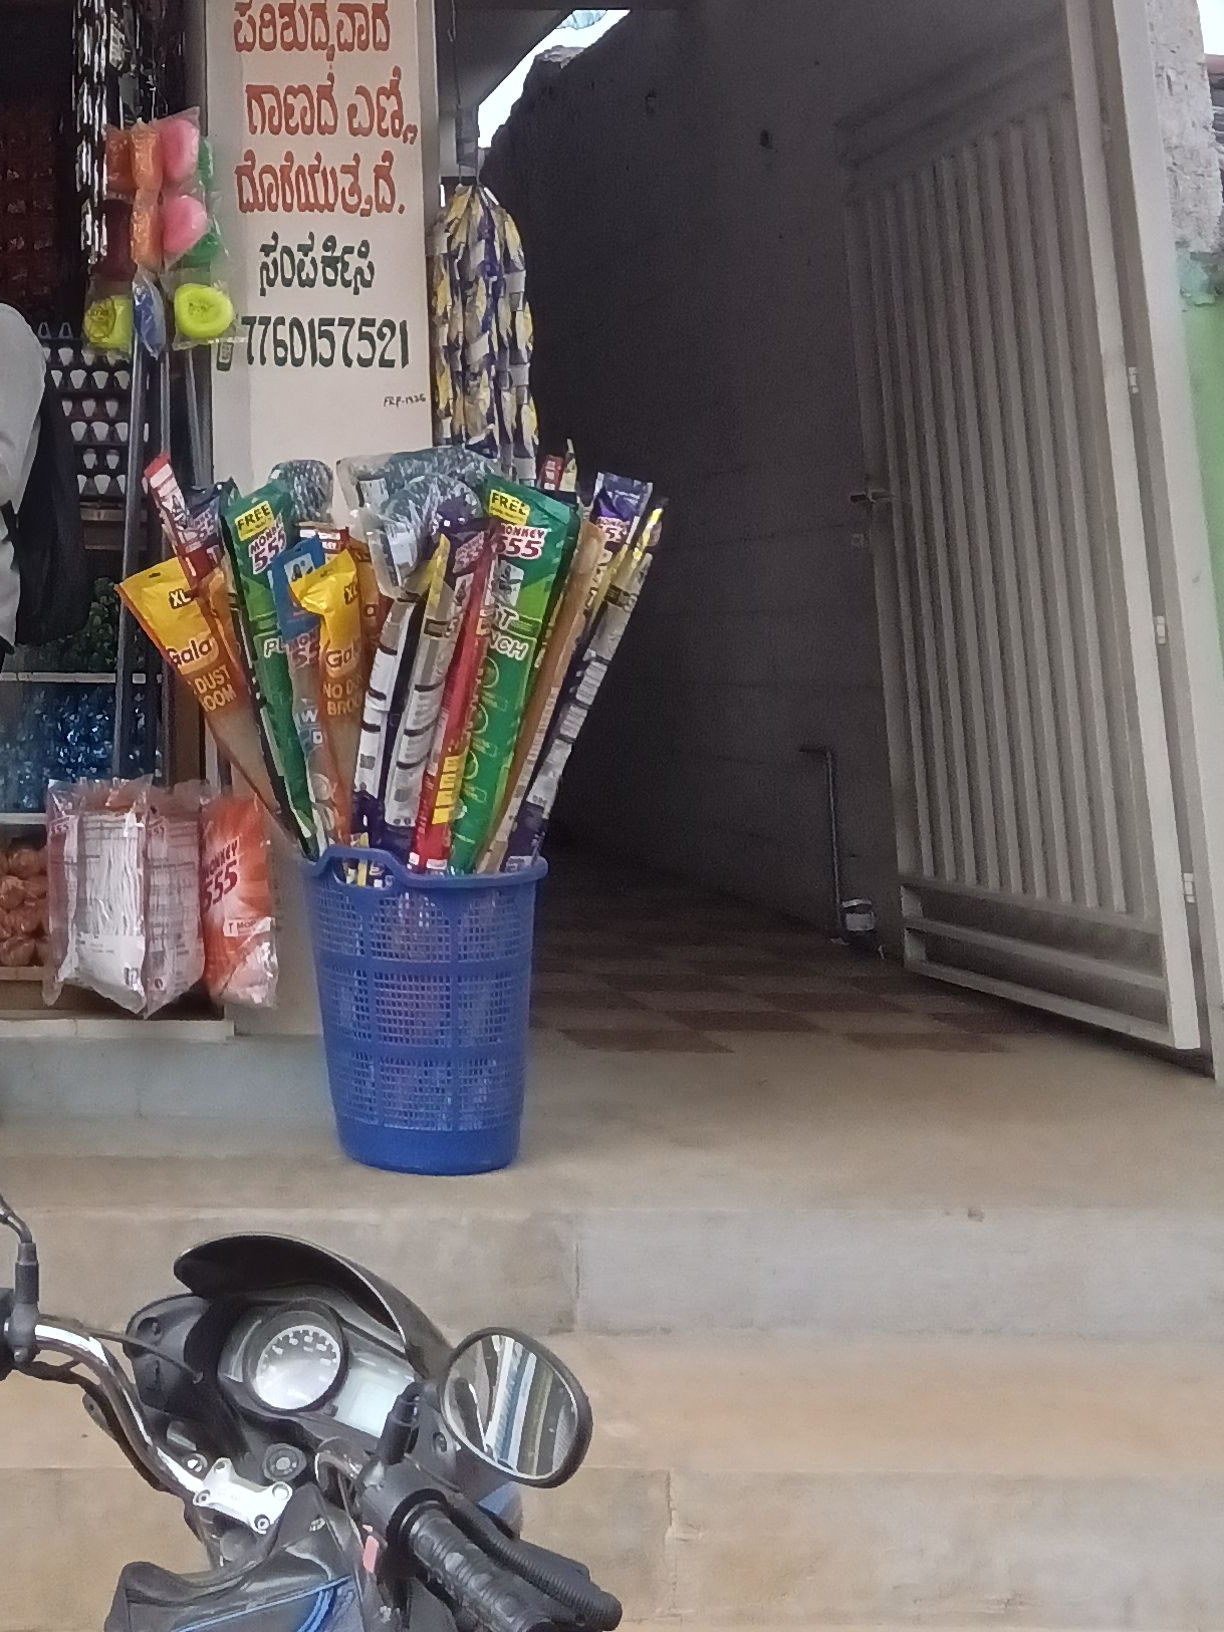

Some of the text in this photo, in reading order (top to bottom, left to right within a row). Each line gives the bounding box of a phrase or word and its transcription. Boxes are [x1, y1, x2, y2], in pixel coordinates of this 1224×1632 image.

[240, 315, 410, 370] 7760157521
[237, 504, 271, 531] FREE
[195, 664, 231, 694] DUST
[200, 684, 237, 713] OOM
